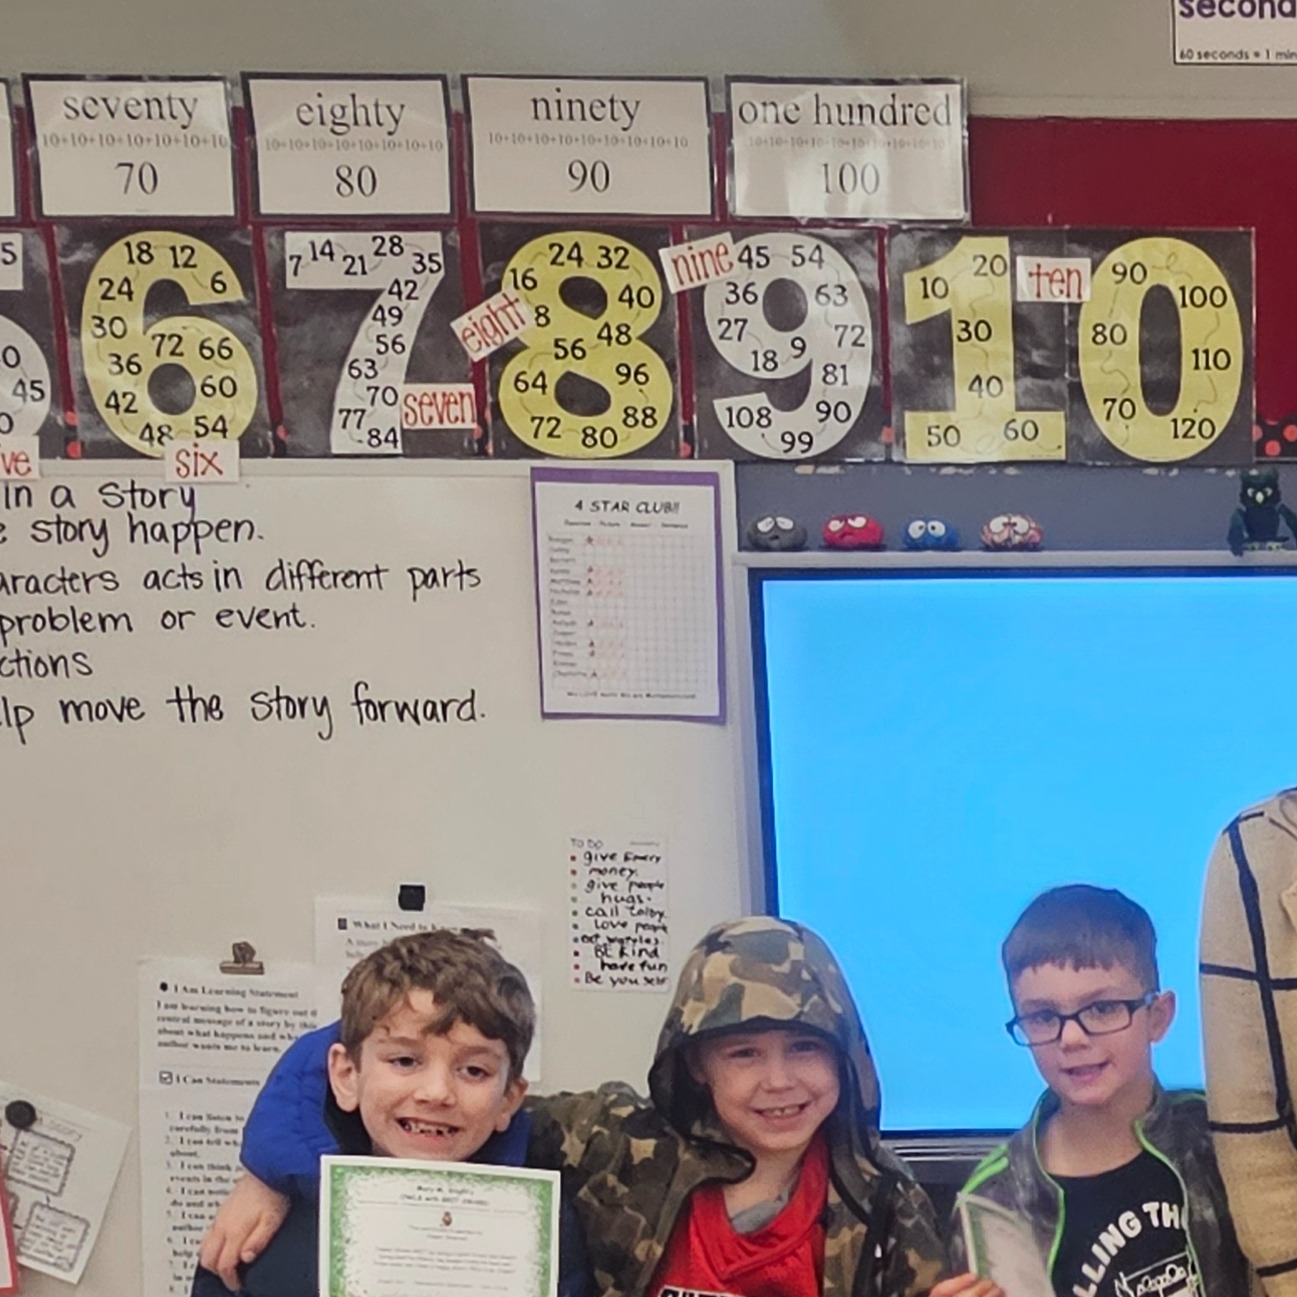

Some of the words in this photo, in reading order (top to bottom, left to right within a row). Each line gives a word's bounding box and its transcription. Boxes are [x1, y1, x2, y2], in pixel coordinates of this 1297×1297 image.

[1197, 50, 1249, 60] seconds
[62, 92, 199, 130] seventy
[296, 93, 406, 135] eighty
[531, 88, 640, 132] ninety
[739, 98, 800, 126] one
[814, 92, 952, 128] hundred
[115, 162, 158, 195] 70
[336, 164, 377, 198] 80
[567, 160, 610, 192] 90
[822, 163, 880, 195] 100
[310, 239, 335, 263] 14
[372, 236, 404, 258] 28
[289, 255, 303, 277] 7
[412, 253, 442, 274] 35
[669, 241, 734, 285] nine
[973, 255, 1007, 278] 20
[1112, 262, 1147, 285] 90
[920, 277, 948, 299] 10
[1028, 264, 1083, 299] ten
[1179, 285, 1227, 308] 100
[459, 295, 525, 355] eight
[956, 320, 992, 343] 30
[1091, 323, 1127, 346] 80
[1192, 348, 1231, 371] 110
[968, 375, 1004, 398] 40
[403, 389, 475, 427] seven
[1103, 398, 1136, 420] 70
[927, 424, 960, 447] 50
[1003, 420, 1039, 442] 60
[1171, 418, 1215, 440] 120
[175, 445, 224, 477] six
[50, 485, 76, 509] a
[590, 500, 629, 513] STAR
[128, 511, 265, 554] happen.
[143, 562, 204, 592] acts
[213, 560, 243, 592] in
[265, 559, 390, 592] different
[407, 560, 482, 602] parts
[0, 605, 133, 647] problem
[161, 607, 196, 630] or
[215, 602, 316, 630] event.
[0, 696, 35, 745] lp
[59, 695, 146, 725] move
[166, 684, 224, 723] the
[351, 681, 486, 727] forward.
[585, 906, 619, 917] call
[601, 959, 635, 971] have
[640, 960, 667, 972] fun
[1142, 1201, 1180, 1230] TH
